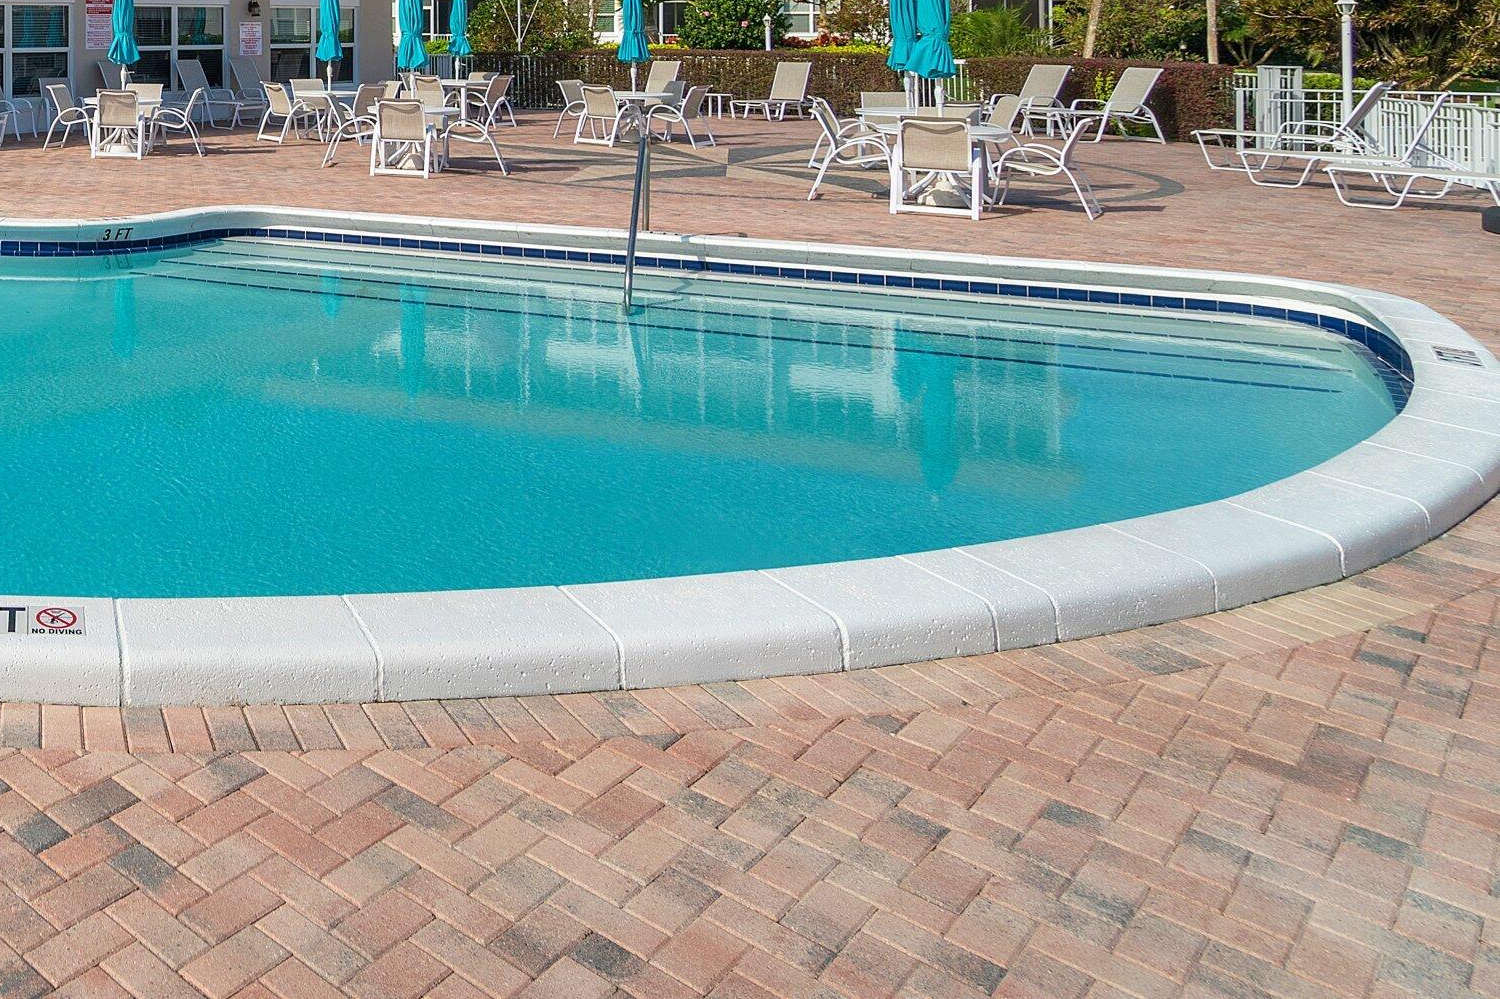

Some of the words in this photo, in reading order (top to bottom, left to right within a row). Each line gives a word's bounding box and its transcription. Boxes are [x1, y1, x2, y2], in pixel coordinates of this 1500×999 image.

[102, 228, 112, 241] 3
[115, 227, 134, 241] FT
[31, 627, 46, 635] NO
[48, 628, 83, 636] DIVING
